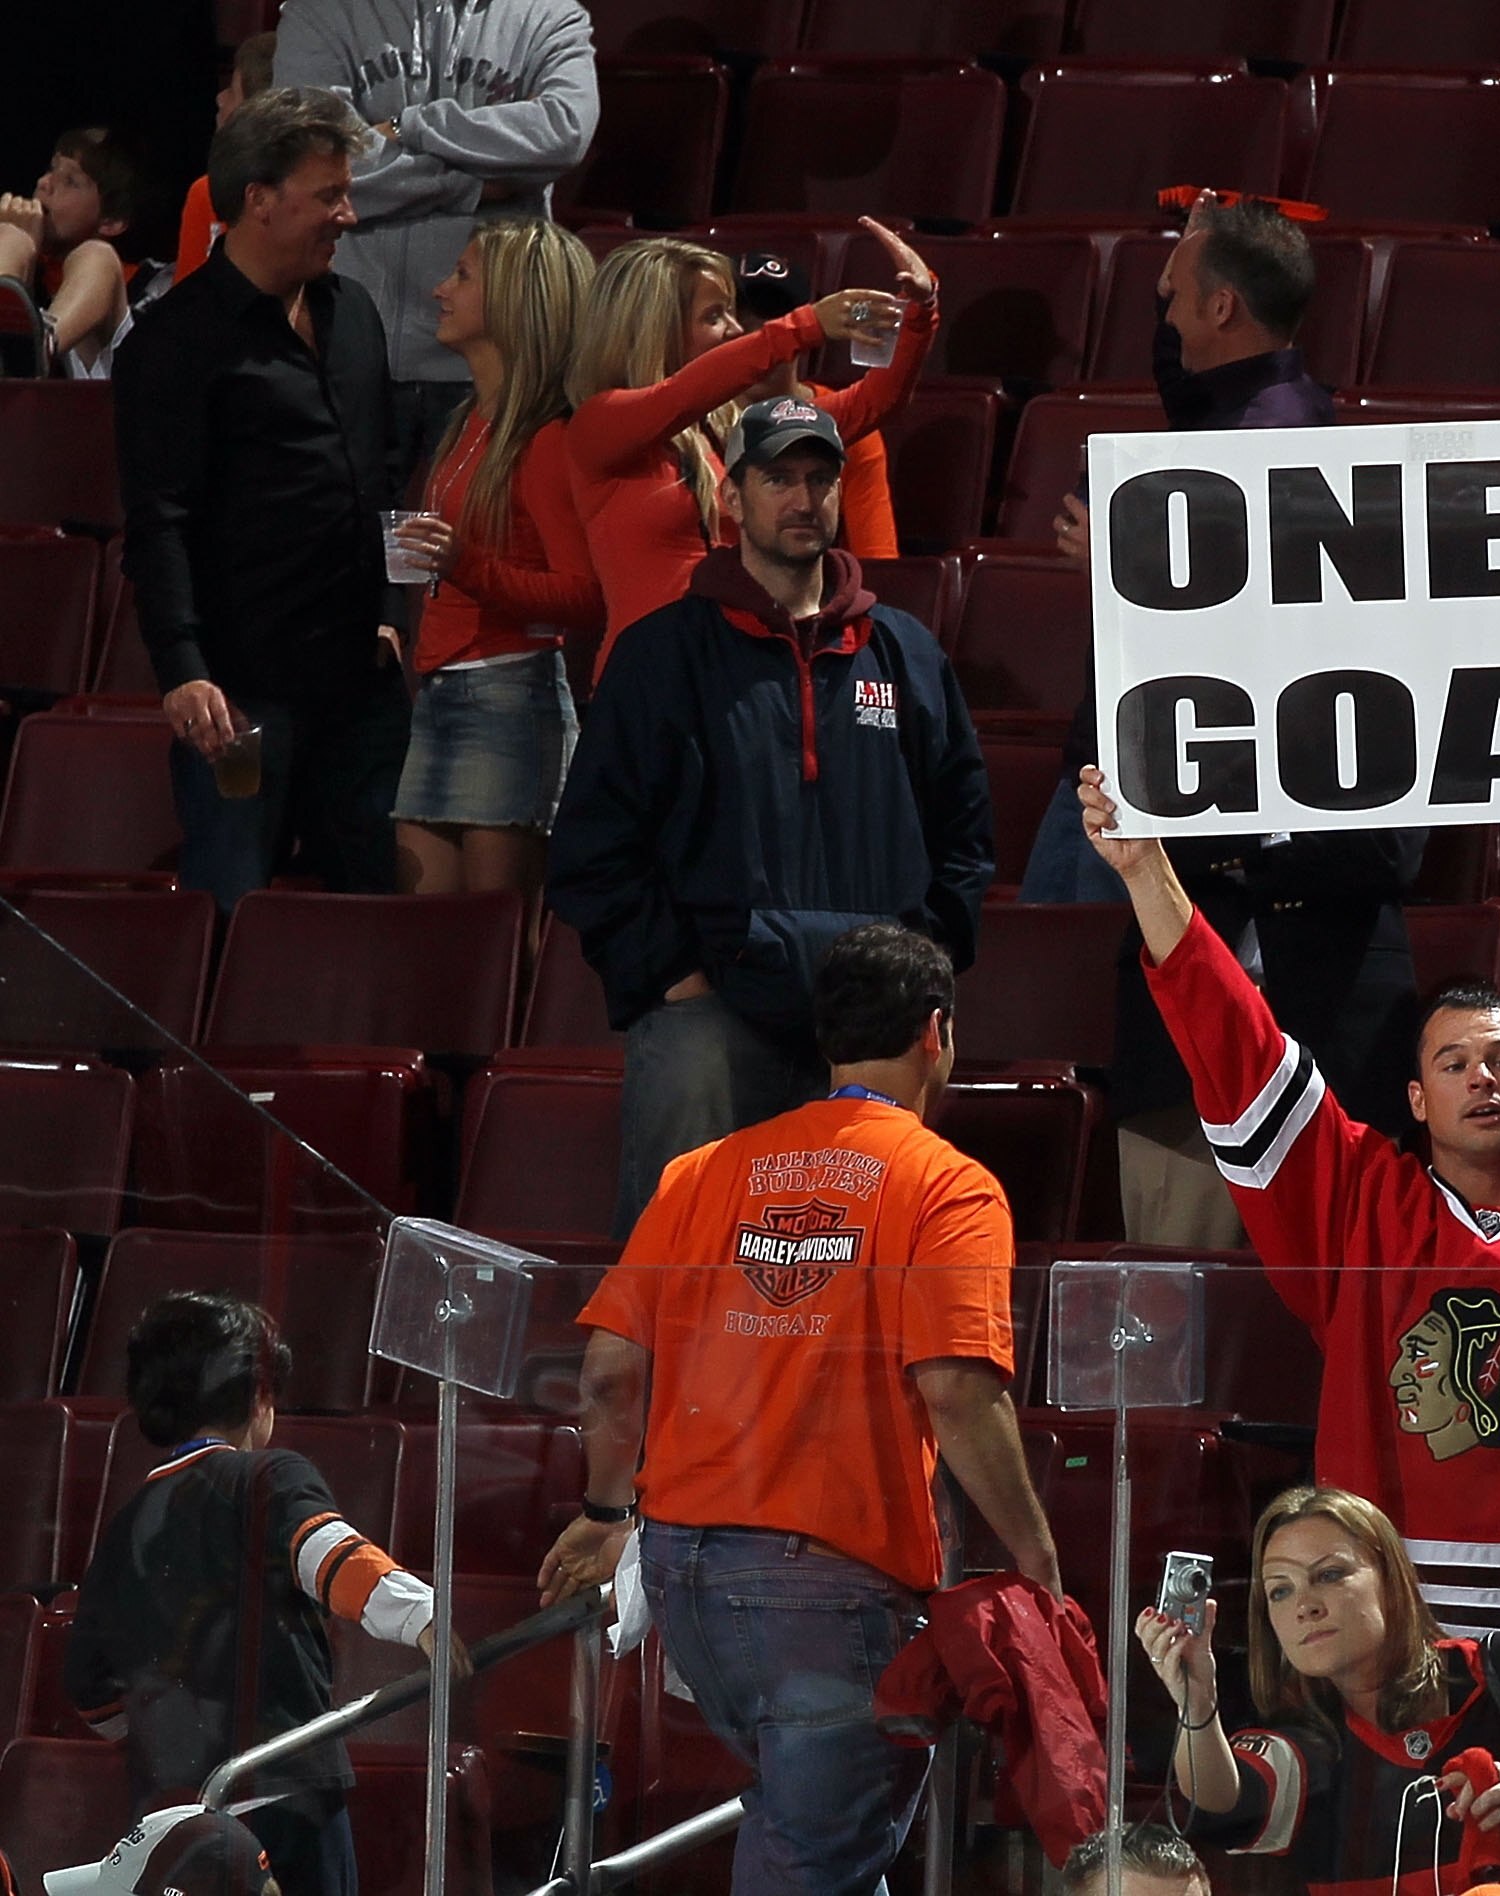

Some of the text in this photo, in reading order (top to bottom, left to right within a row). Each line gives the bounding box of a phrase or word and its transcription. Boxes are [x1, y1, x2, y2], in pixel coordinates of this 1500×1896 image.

[776, 1209, 832, 1234] MOOR
[739, 1231, 855, 1265] HARLEY-AVIDSON
[724, 1310, 832, 1338] HUNGAR
